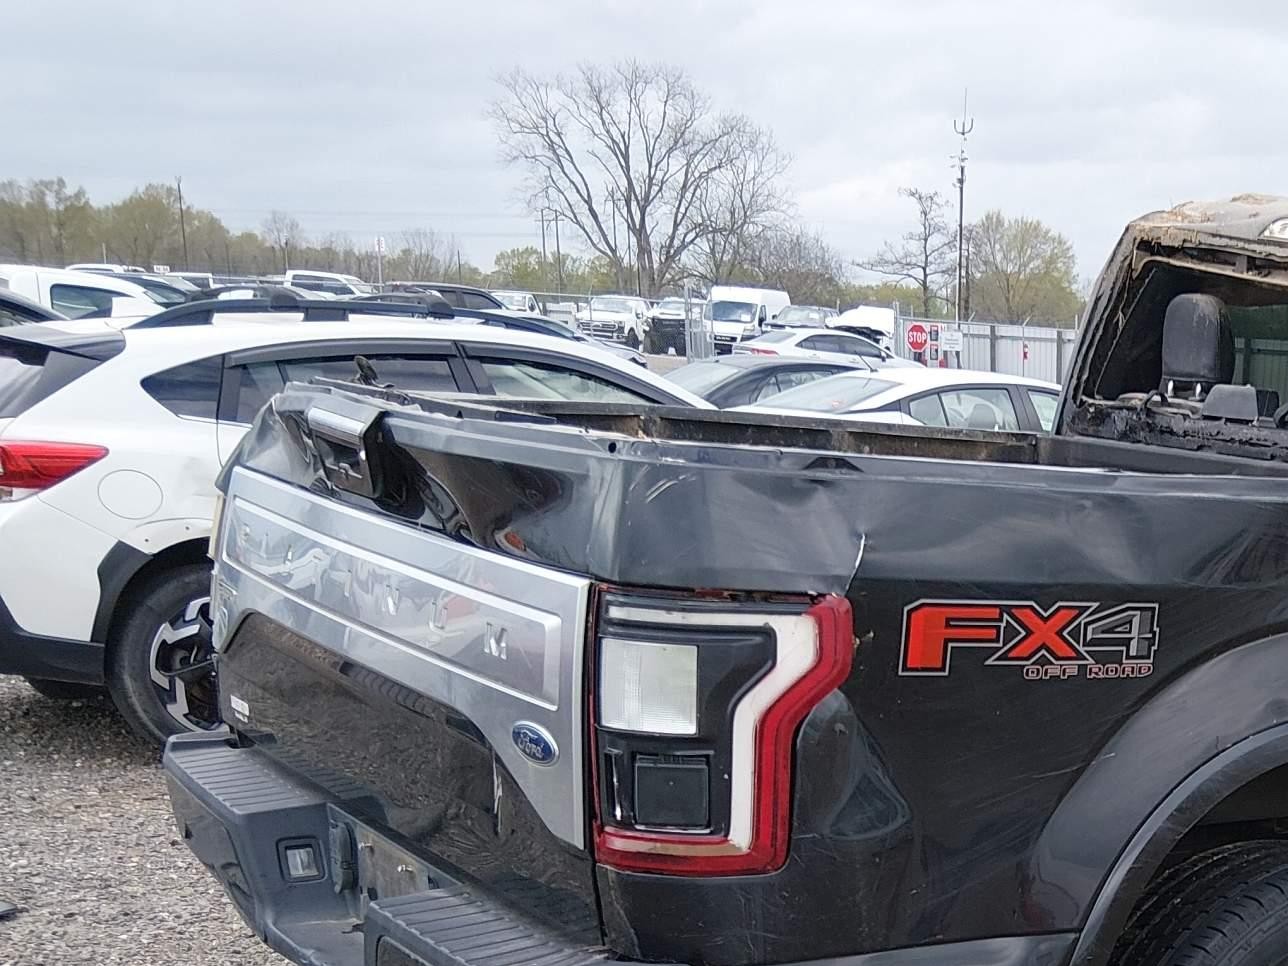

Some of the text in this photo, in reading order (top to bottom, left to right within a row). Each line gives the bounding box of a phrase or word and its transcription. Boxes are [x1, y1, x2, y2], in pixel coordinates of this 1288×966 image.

[907, 331, 927, 344] STOP
[239, 521, 508, 660] PLINUM
[899, 599, 1159, 675] FX4
[1024, 664, 1154, 680] OFF ROAD
